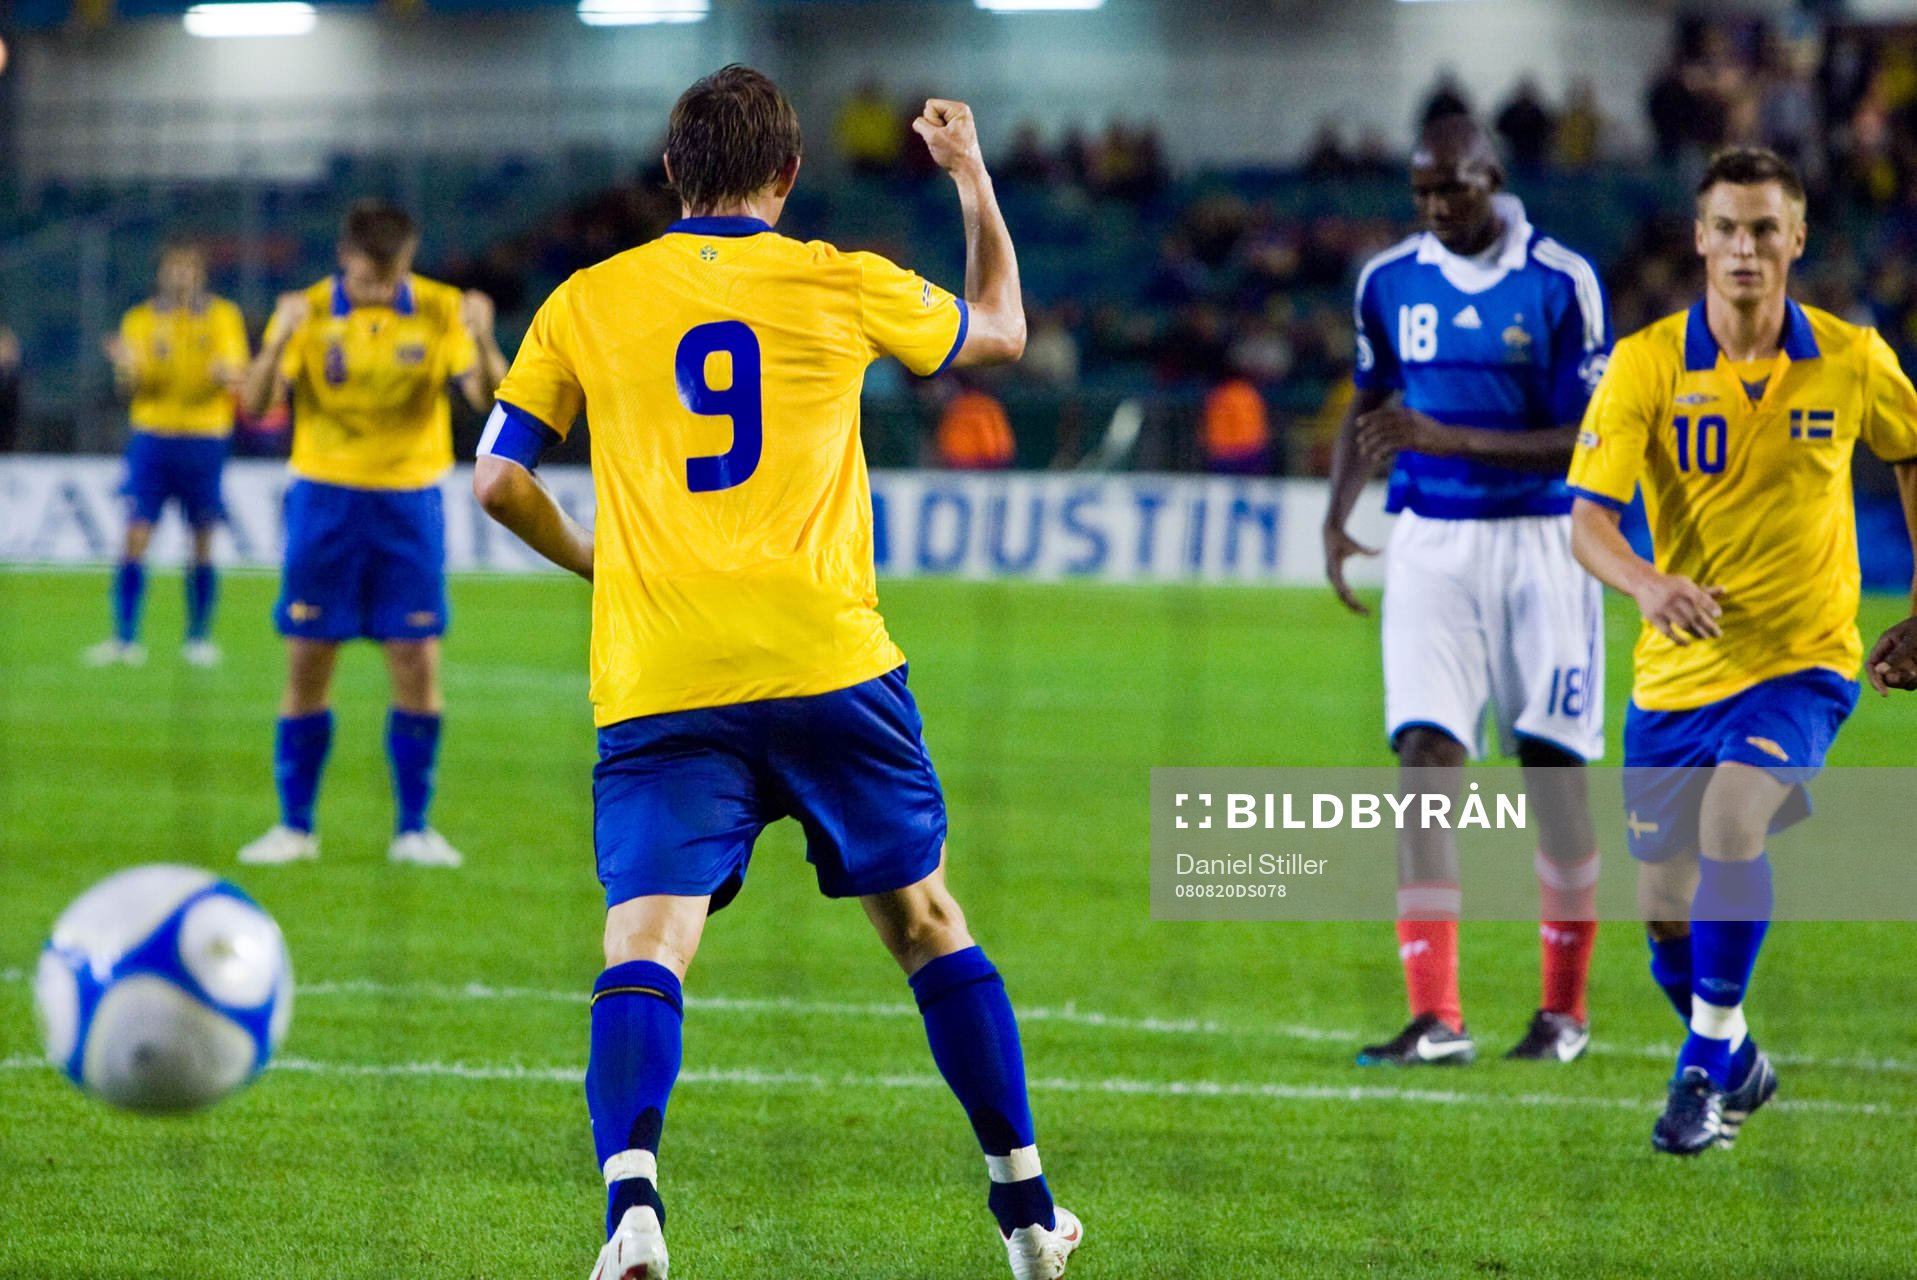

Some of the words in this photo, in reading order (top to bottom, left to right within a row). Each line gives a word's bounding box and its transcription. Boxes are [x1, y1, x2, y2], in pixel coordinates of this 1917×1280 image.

[1399, 303, 1438, 362] 18
[675, 320, 762, 493] 9
[1672, 415, 1727, 474] 10
[1547, 667, 1583, 717] 18
